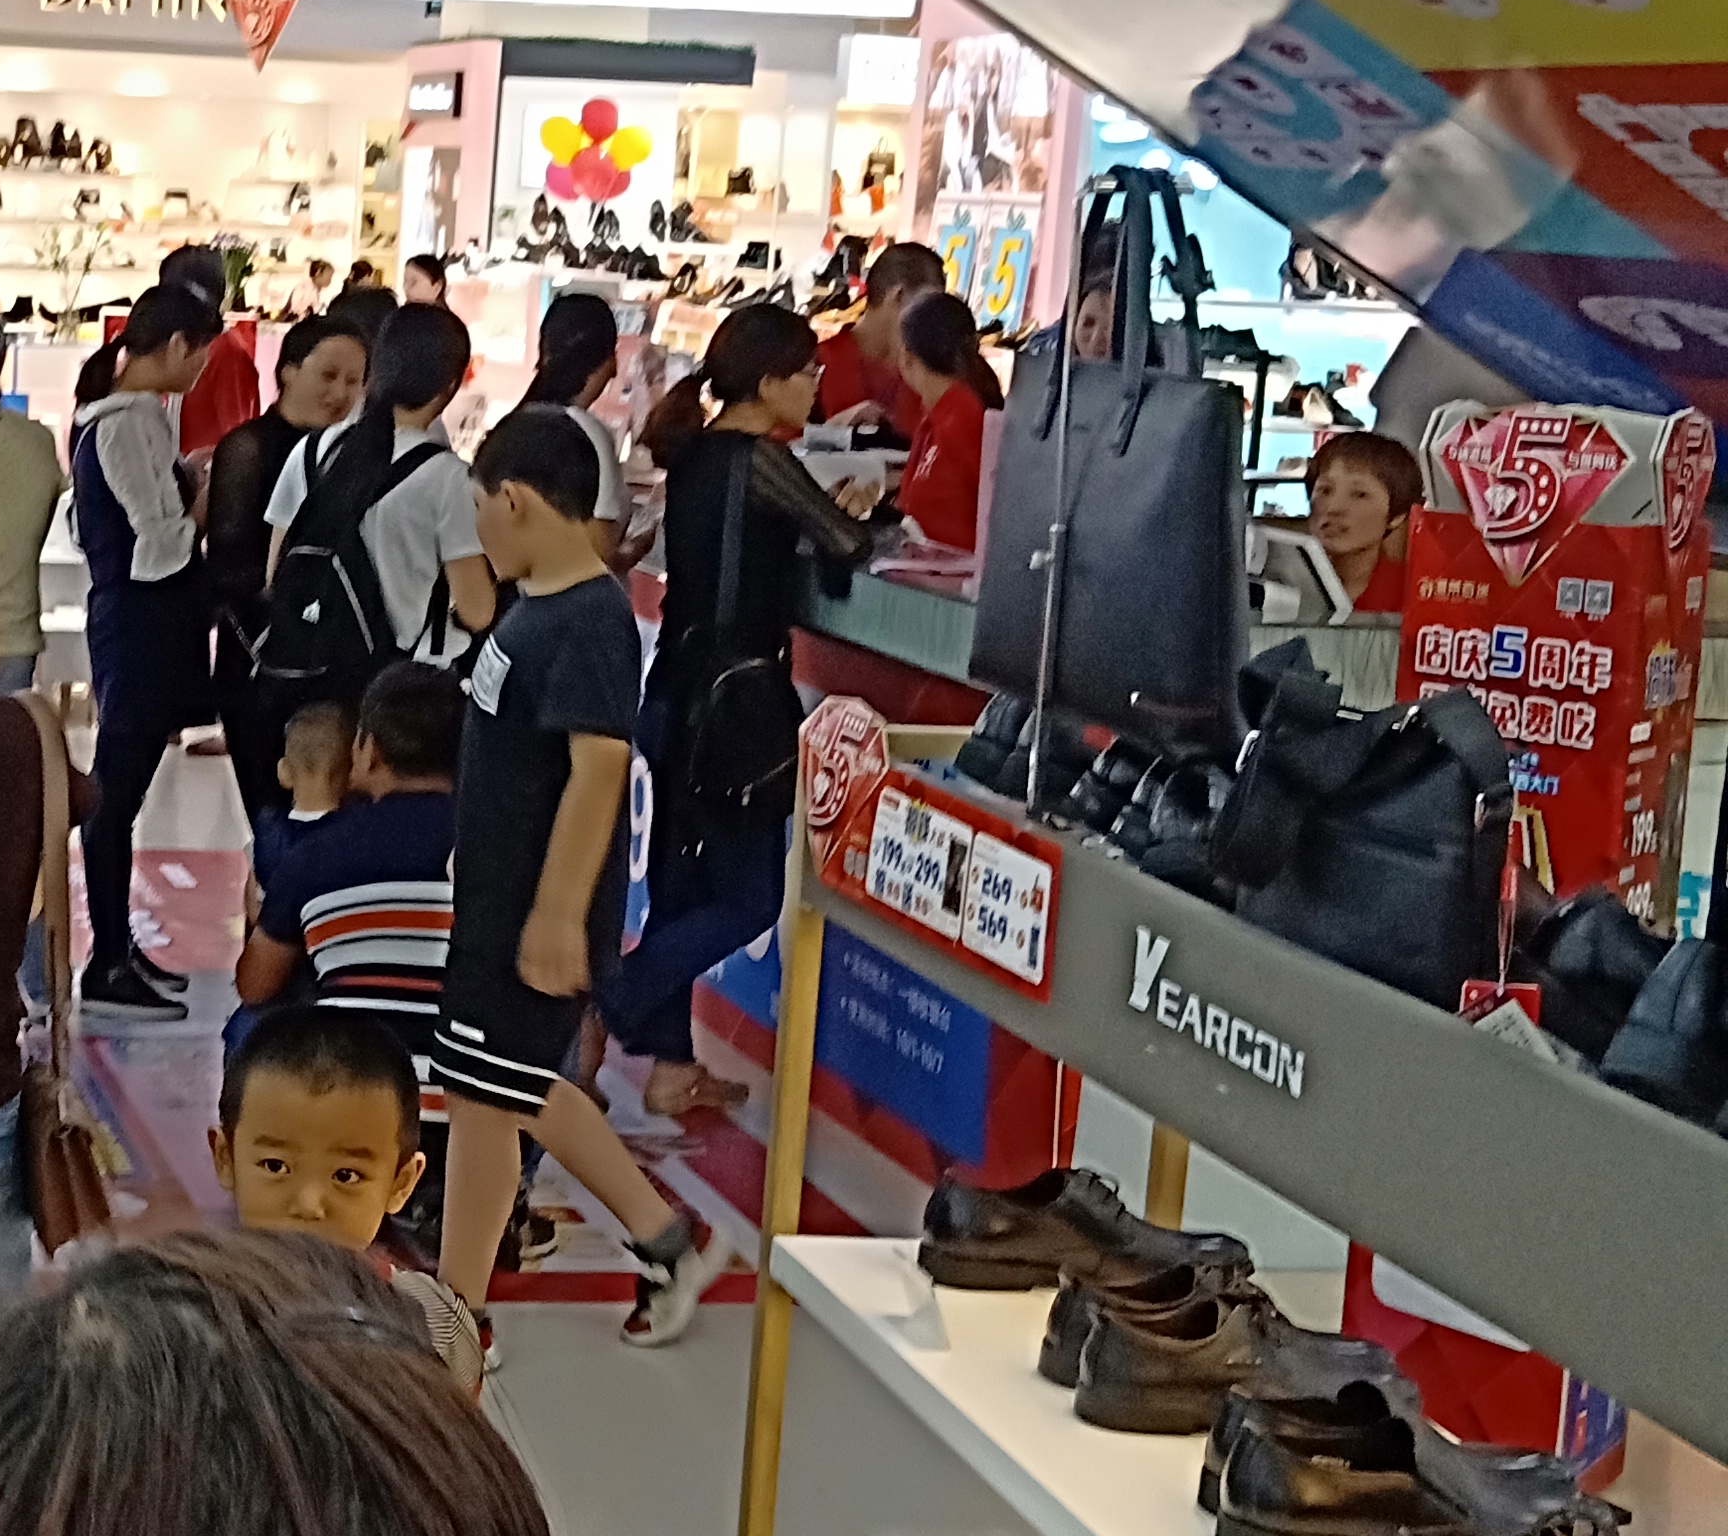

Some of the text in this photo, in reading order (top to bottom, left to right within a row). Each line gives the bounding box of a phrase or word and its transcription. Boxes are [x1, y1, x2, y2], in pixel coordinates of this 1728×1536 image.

[1482, 413, 1572, 540] 5
[1414, 624, 1614, 695] 店庆5周年
[1419, 680, 1597, 751] 免费吃
[981, 866, 1013, 907] 269
[976, 904, 1009, 944] 569
[1128, 924, 1306, 1100] YEARCON
